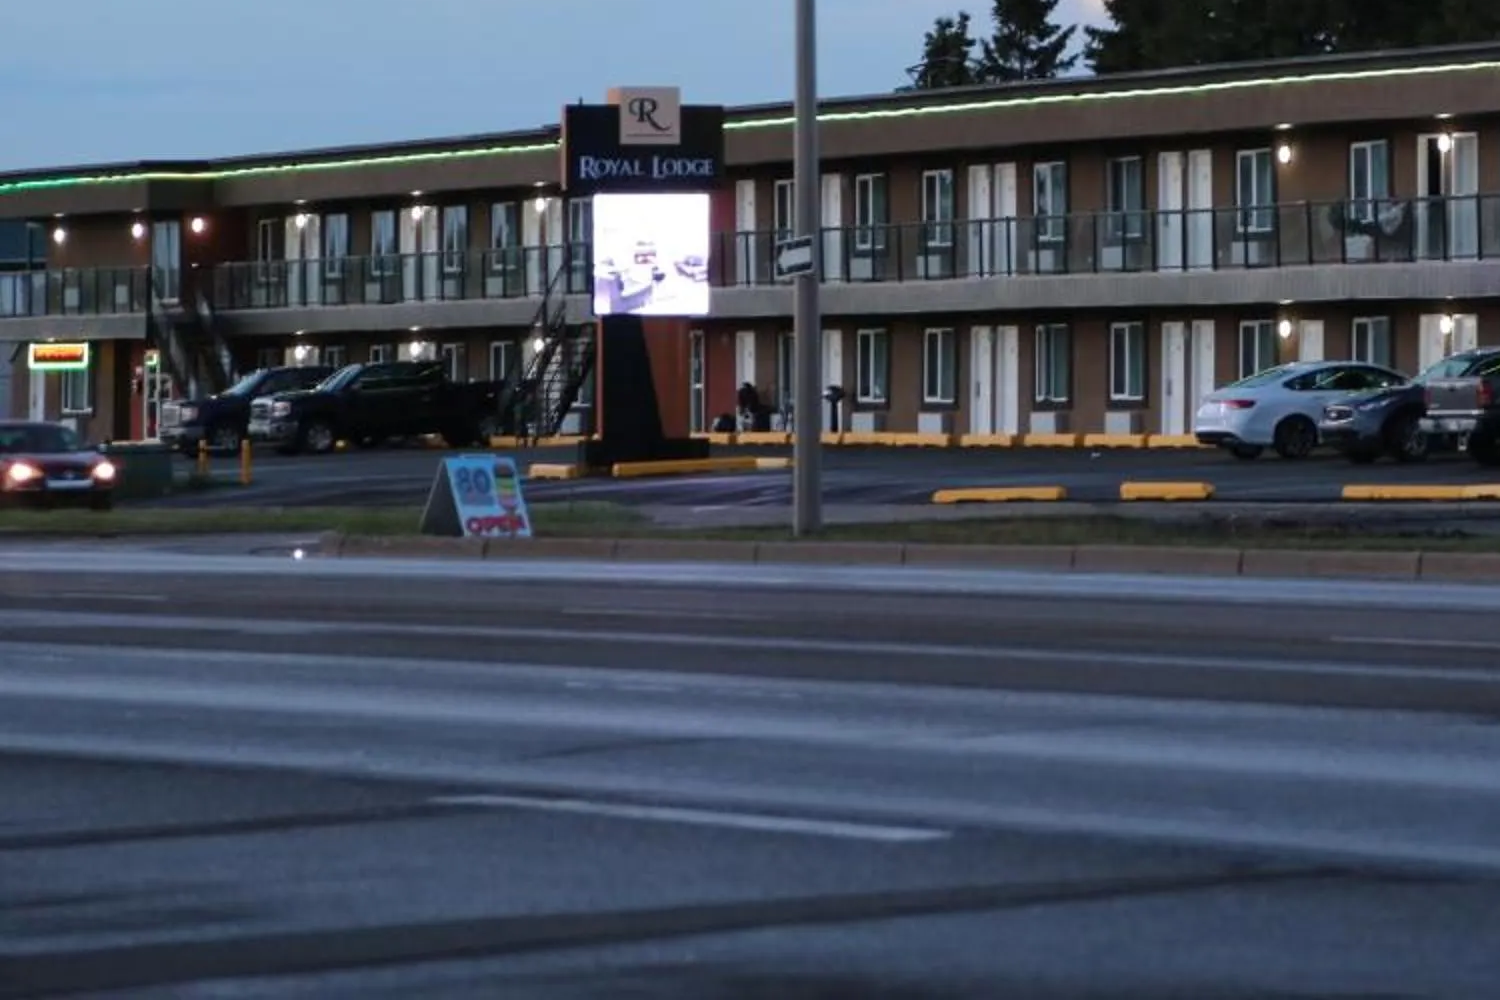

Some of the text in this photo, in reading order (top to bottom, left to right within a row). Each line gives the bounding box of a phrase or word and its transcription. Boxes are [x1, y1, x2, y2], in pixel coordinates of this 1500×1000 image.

[628, 97, 672, 131] R
[579, 155, 714, 180] ROYAL LODGE
